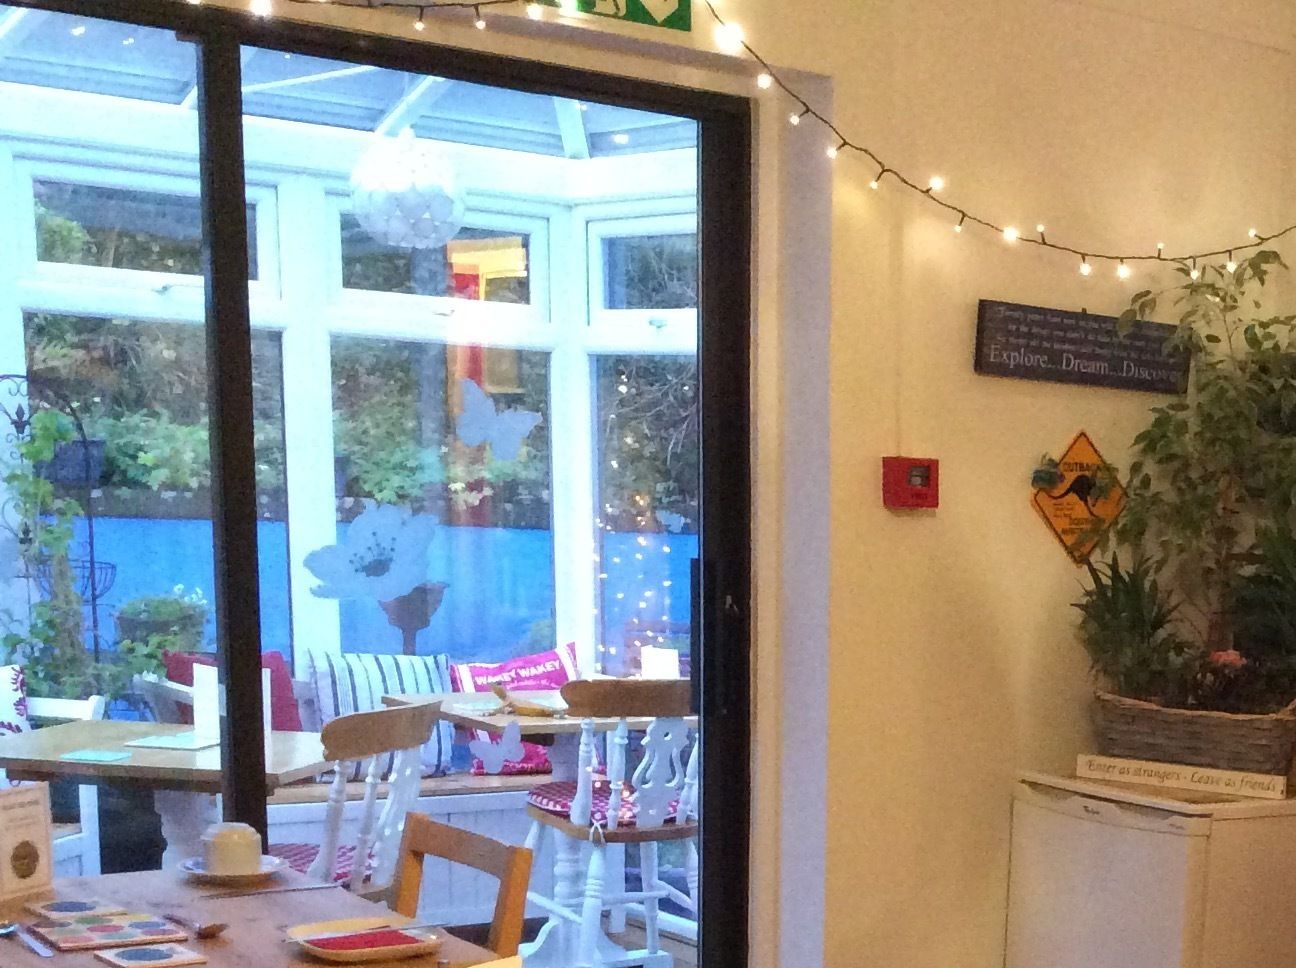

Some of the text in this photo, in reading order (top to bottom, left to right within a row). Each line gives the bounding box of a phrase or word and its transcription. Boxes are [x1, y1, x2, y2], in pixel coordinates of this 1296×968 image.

[1121, 360, 1179, 383] Discove
[516, 660, 560, 678] WAKEY
[1087, 758, 1117, 772] Enter
[1118, 766, 1130, 777] as
[1132, 765, 1181, 784] strangers
[1190, 771, 1222, 786] Leave
[1224, 777, 1236, 788] as
[1238, 775, 1277, 793] friends
